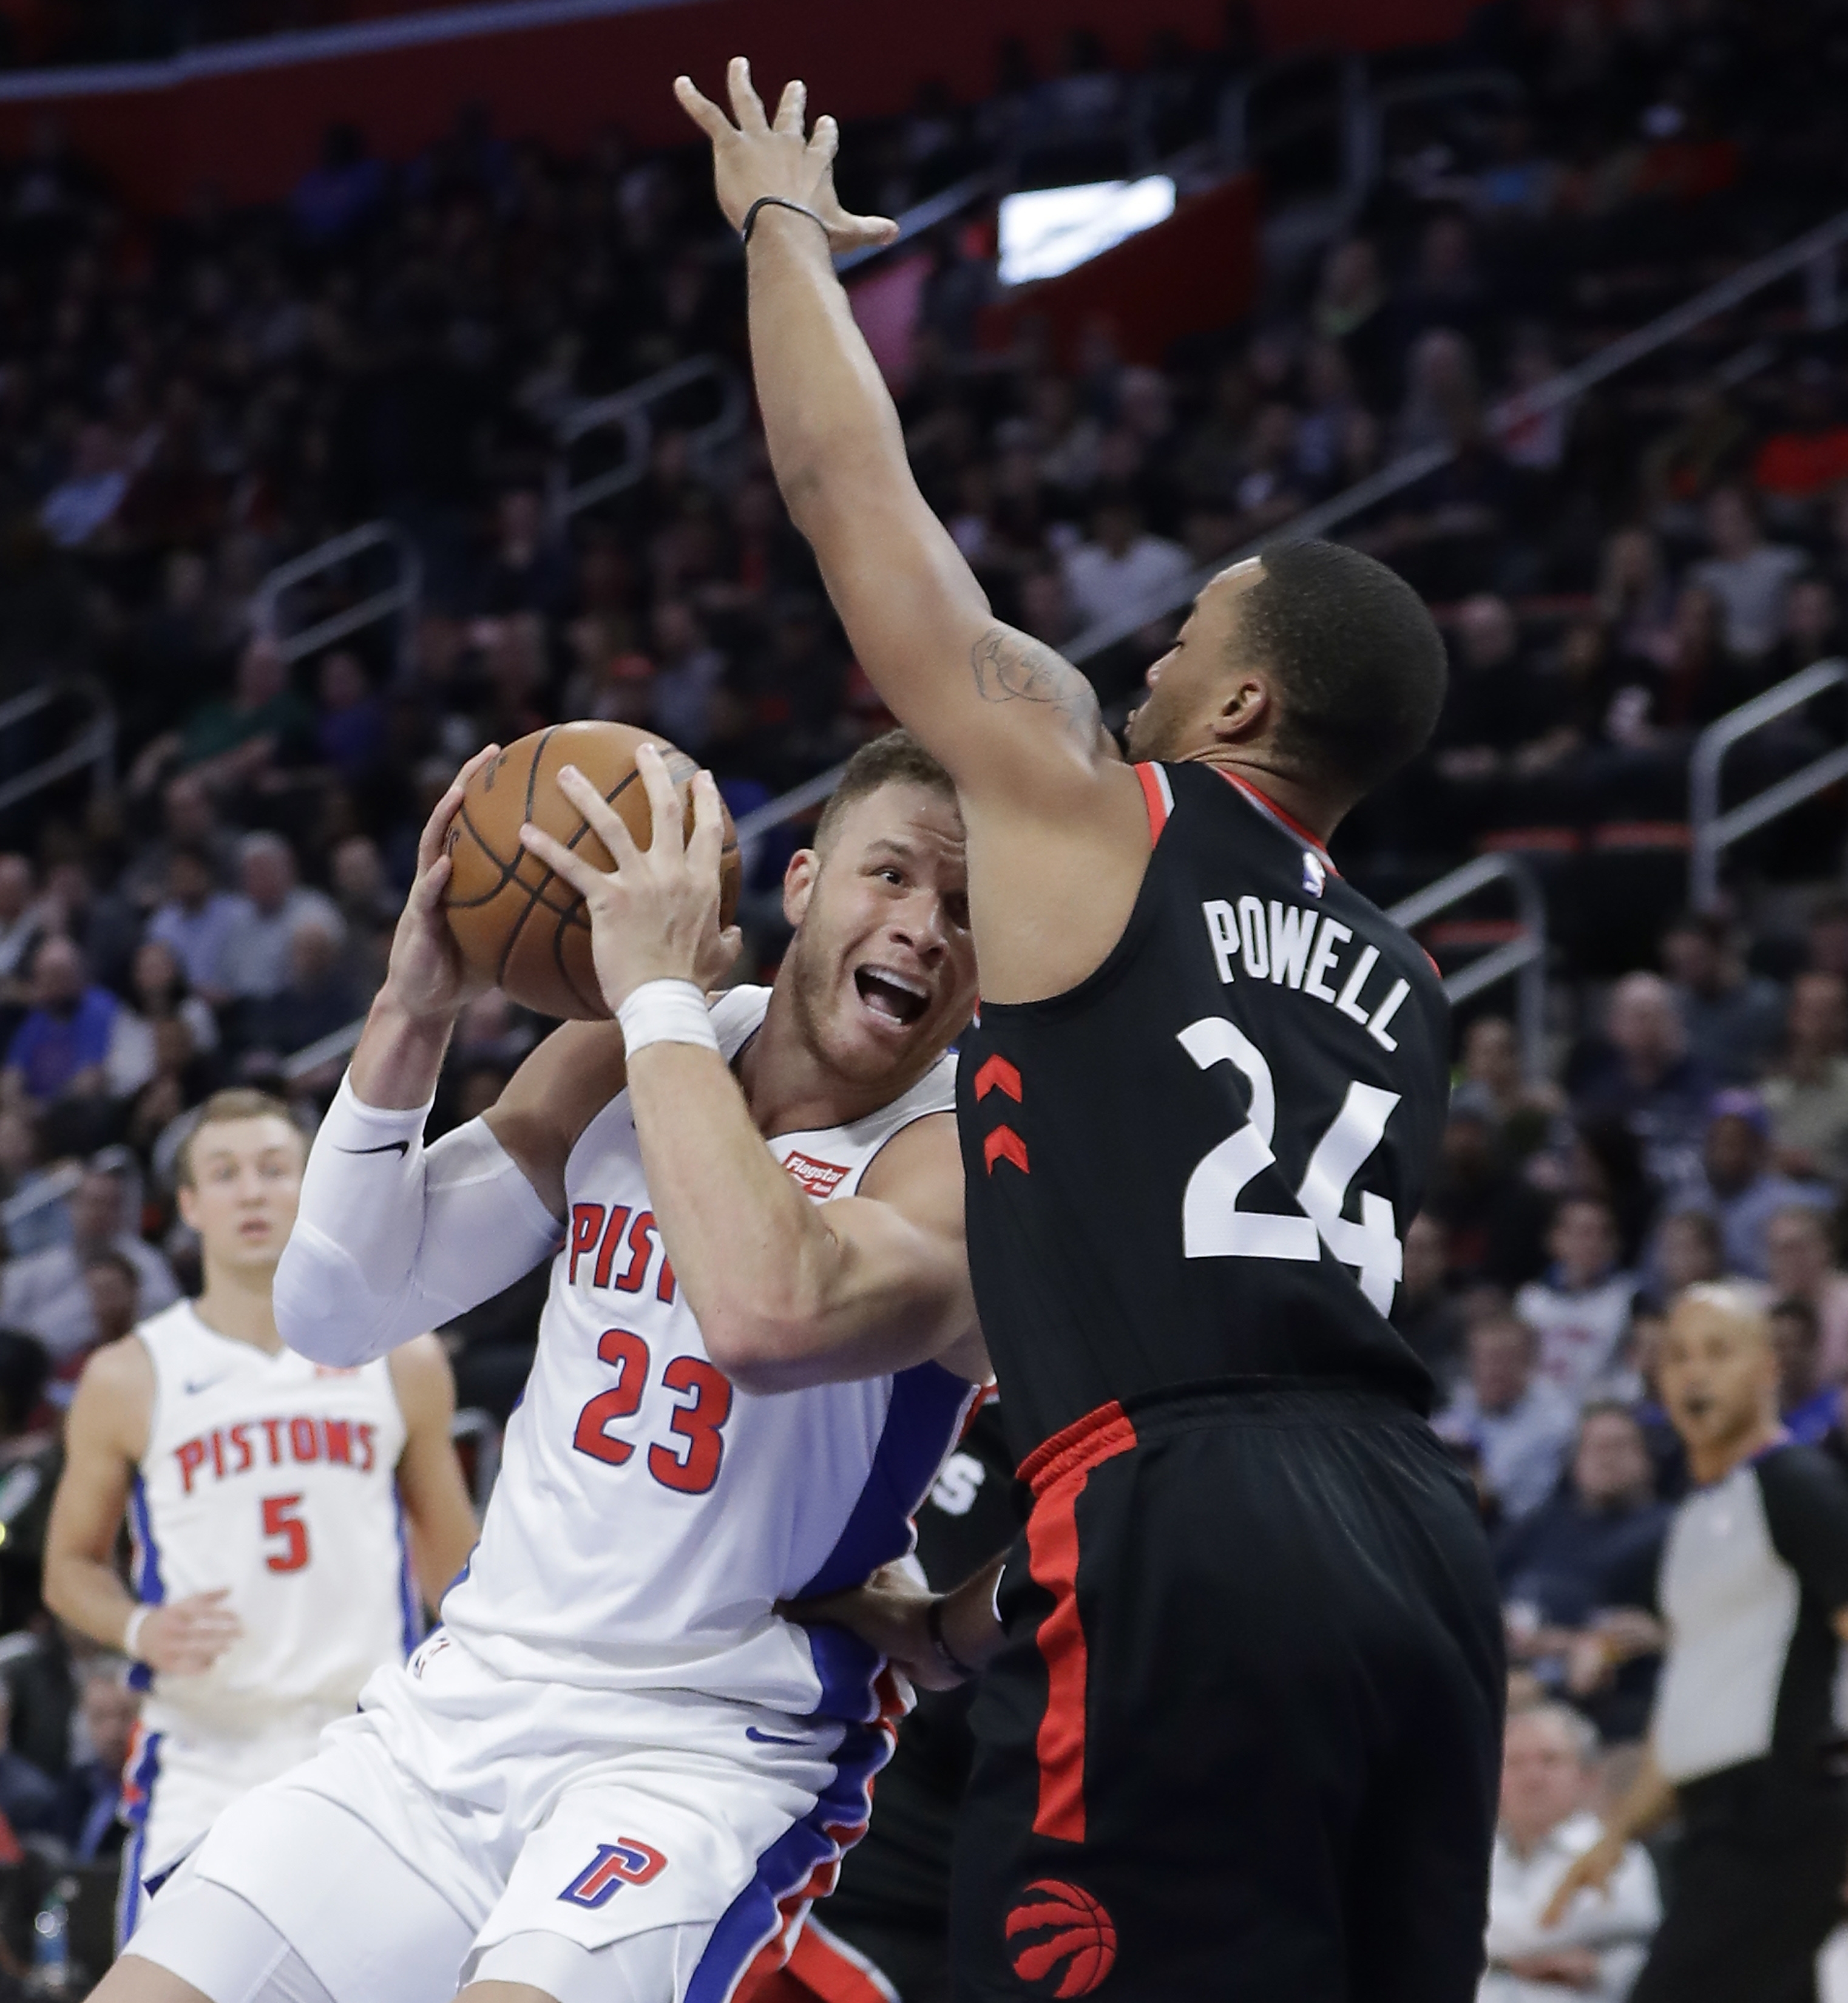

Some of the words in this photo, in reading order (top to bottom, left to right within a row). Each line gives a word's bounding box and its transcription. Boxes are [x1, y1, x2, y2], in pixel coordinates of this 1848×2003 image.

[1202, 895, 1410, 1052] POWELL
[786, 1156, 844, 1183] Flagstar
[1176, 1017, 1403, 1319] 24
[173, 1417, 376, 1492] PISTONS
[573, 1328, 733, 1496] 23
[262, 1494, 308, 1571] 5
